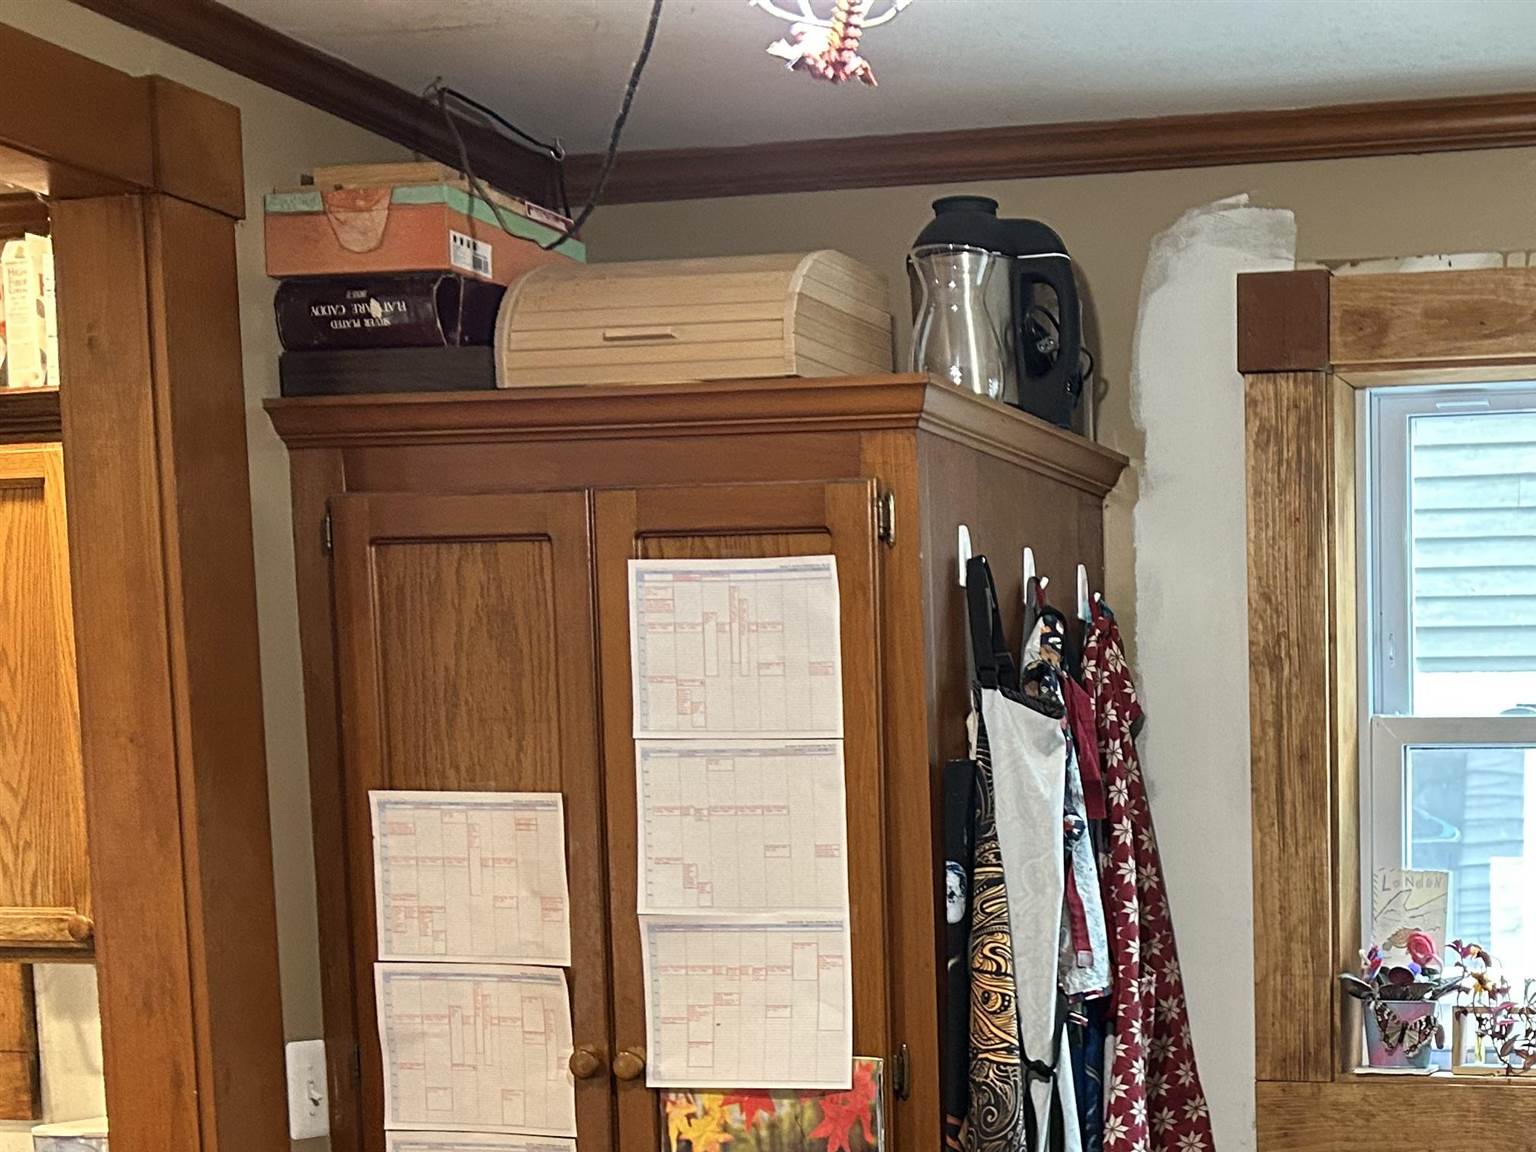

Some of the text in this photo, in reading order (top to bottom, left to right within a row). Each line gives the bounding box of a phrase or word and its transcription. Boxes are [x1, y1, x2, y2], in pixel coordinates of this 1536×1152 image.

[309, 300, 408, 317] FLATARE CADDY
[330, 319, 362, 330] PLATED
